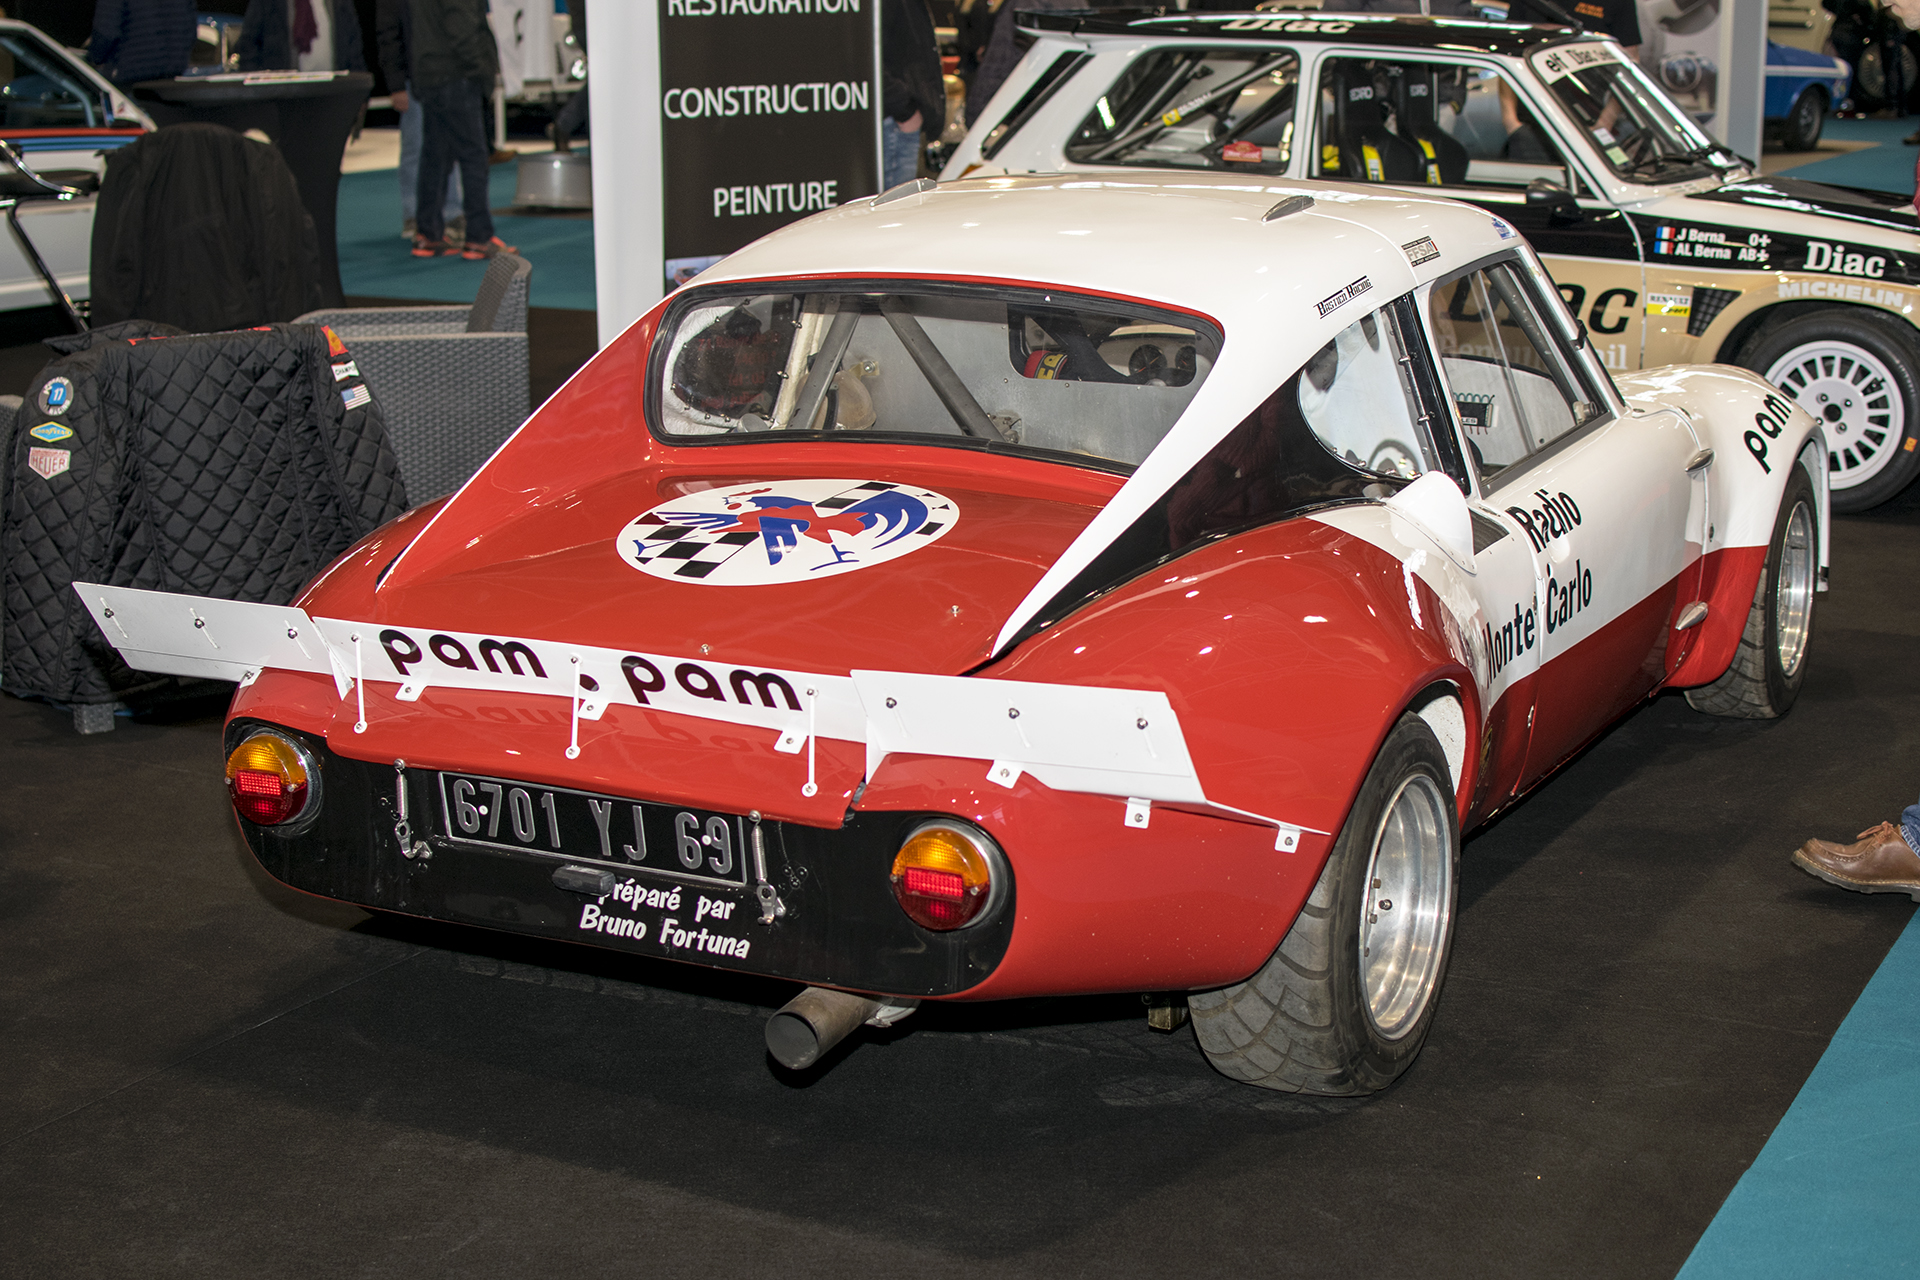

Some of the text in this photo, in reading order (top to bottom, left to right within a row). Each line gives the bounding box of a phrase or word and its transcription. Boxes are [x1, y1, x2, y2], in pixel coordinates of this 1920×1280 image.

[668, 0, 860, 16] RESTAURATION
[1220, 19, 1356, 34] Diac
[1545, 52, 1569, 72] elf
[663, 81, 869, 119] CONSTRUCTION
[713, 180, 838, 218] PEINTURE
[1676, 227, 1688, 241] J
[1688, 228, 1726, 243] Berna
[1405, 242, 1435, 261] FFSA
[1674, 242, 1770, 262] AL Berna AB+
[1802, 241, 1886, 278] Diac
[1650, 295, 1689, 305] RENAULT
[1778, 281, 1905, 308] MICHELIN
[53, 387, 64, 401] 17
[1743, 393, 1793, 475] pam
[32, 456, 66, 475] HEUER
[1504, 489, 1582, 554] Radio
[1546, 558, 1592, 635] Carlo
[379, 628, 803, 712] pam pam
[453, 779, 733, 874] 6701 YJ 69
[694, 895, 735, 922] par
[579, 904, 751, 960] Bruno Fortuna
